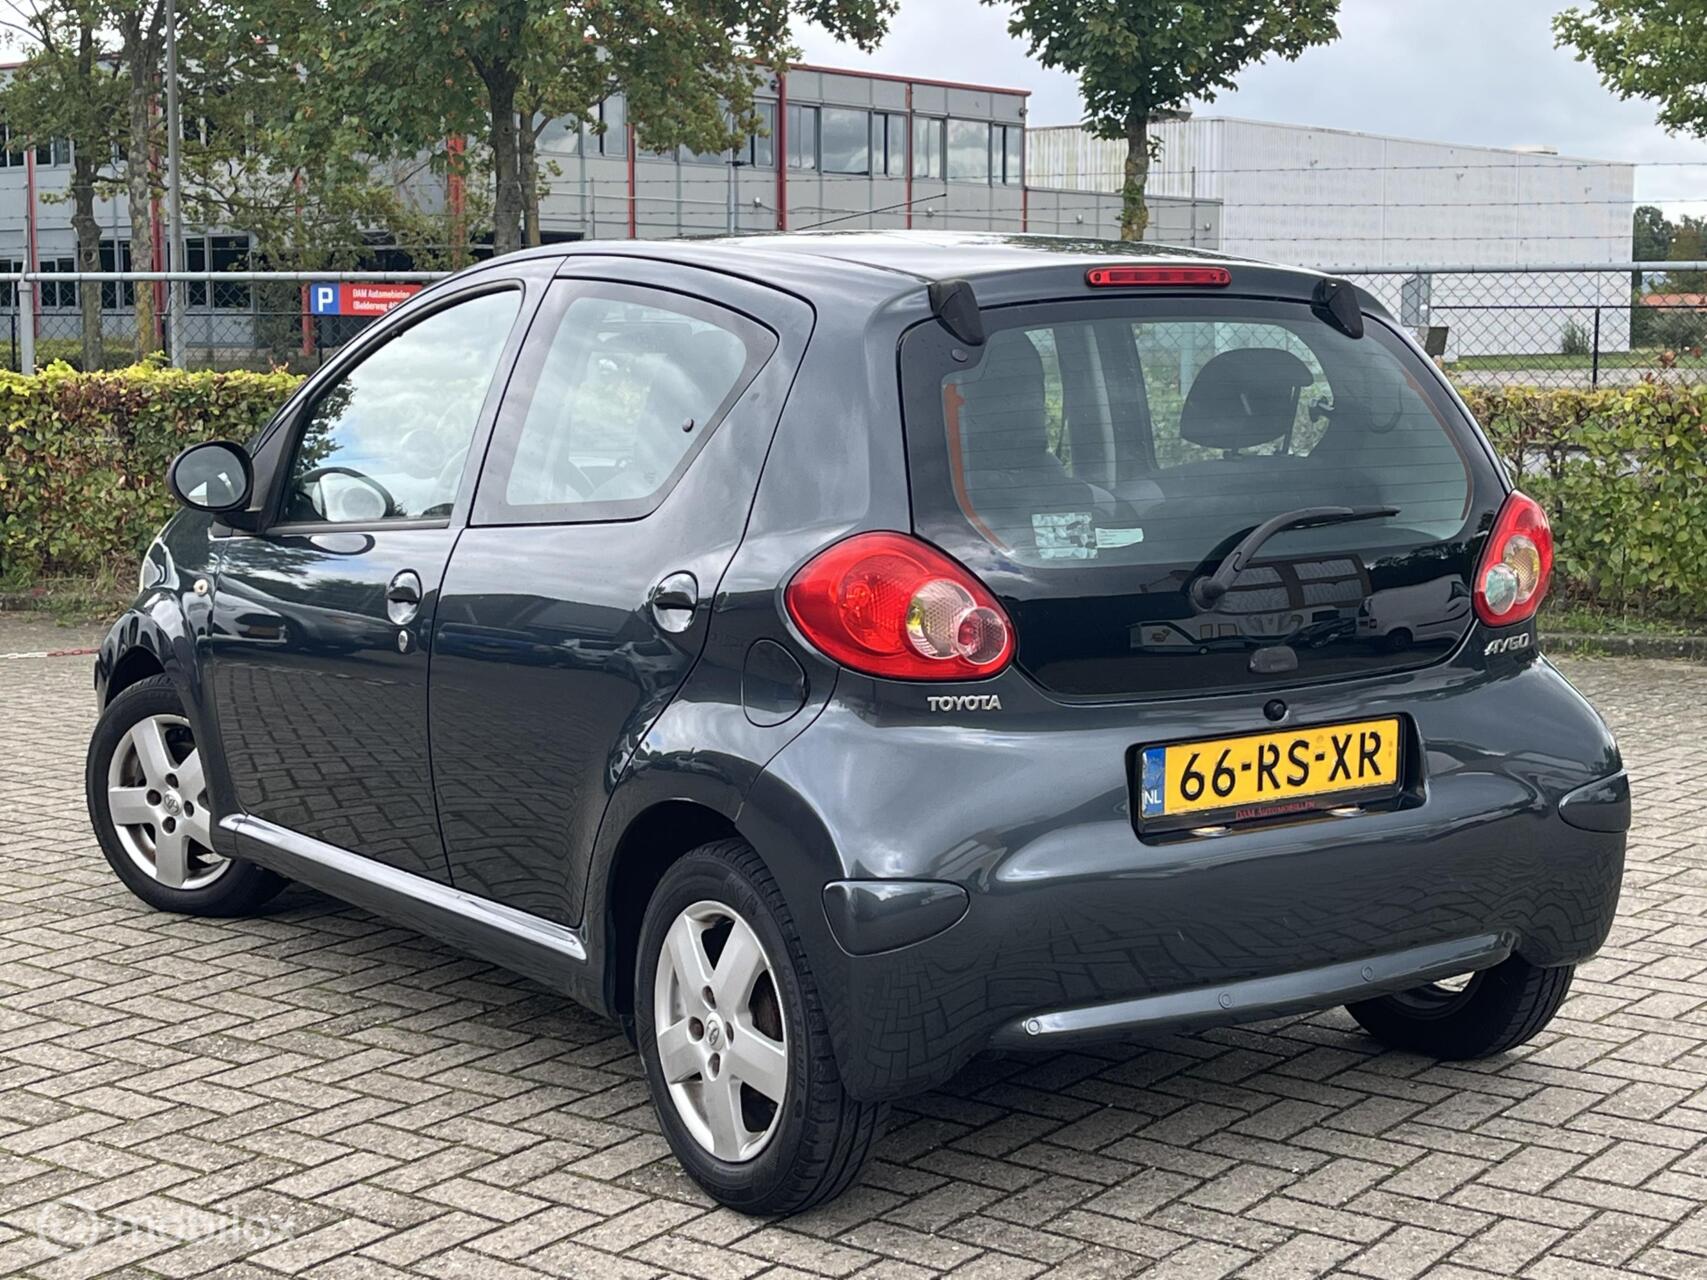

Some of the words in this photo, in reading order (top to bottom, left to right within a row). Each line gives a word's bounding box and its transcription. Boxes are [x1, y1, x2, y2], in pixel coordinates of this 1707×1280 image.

[318, 287, 334, 313] P
[1484, 632, 1530, 656] AYGO
[927, 694, 1002, 712] TOYOTA
[1180, 730, 1382, 801] 66-RS-XR
[1143, 790, 1162, 805] NL
